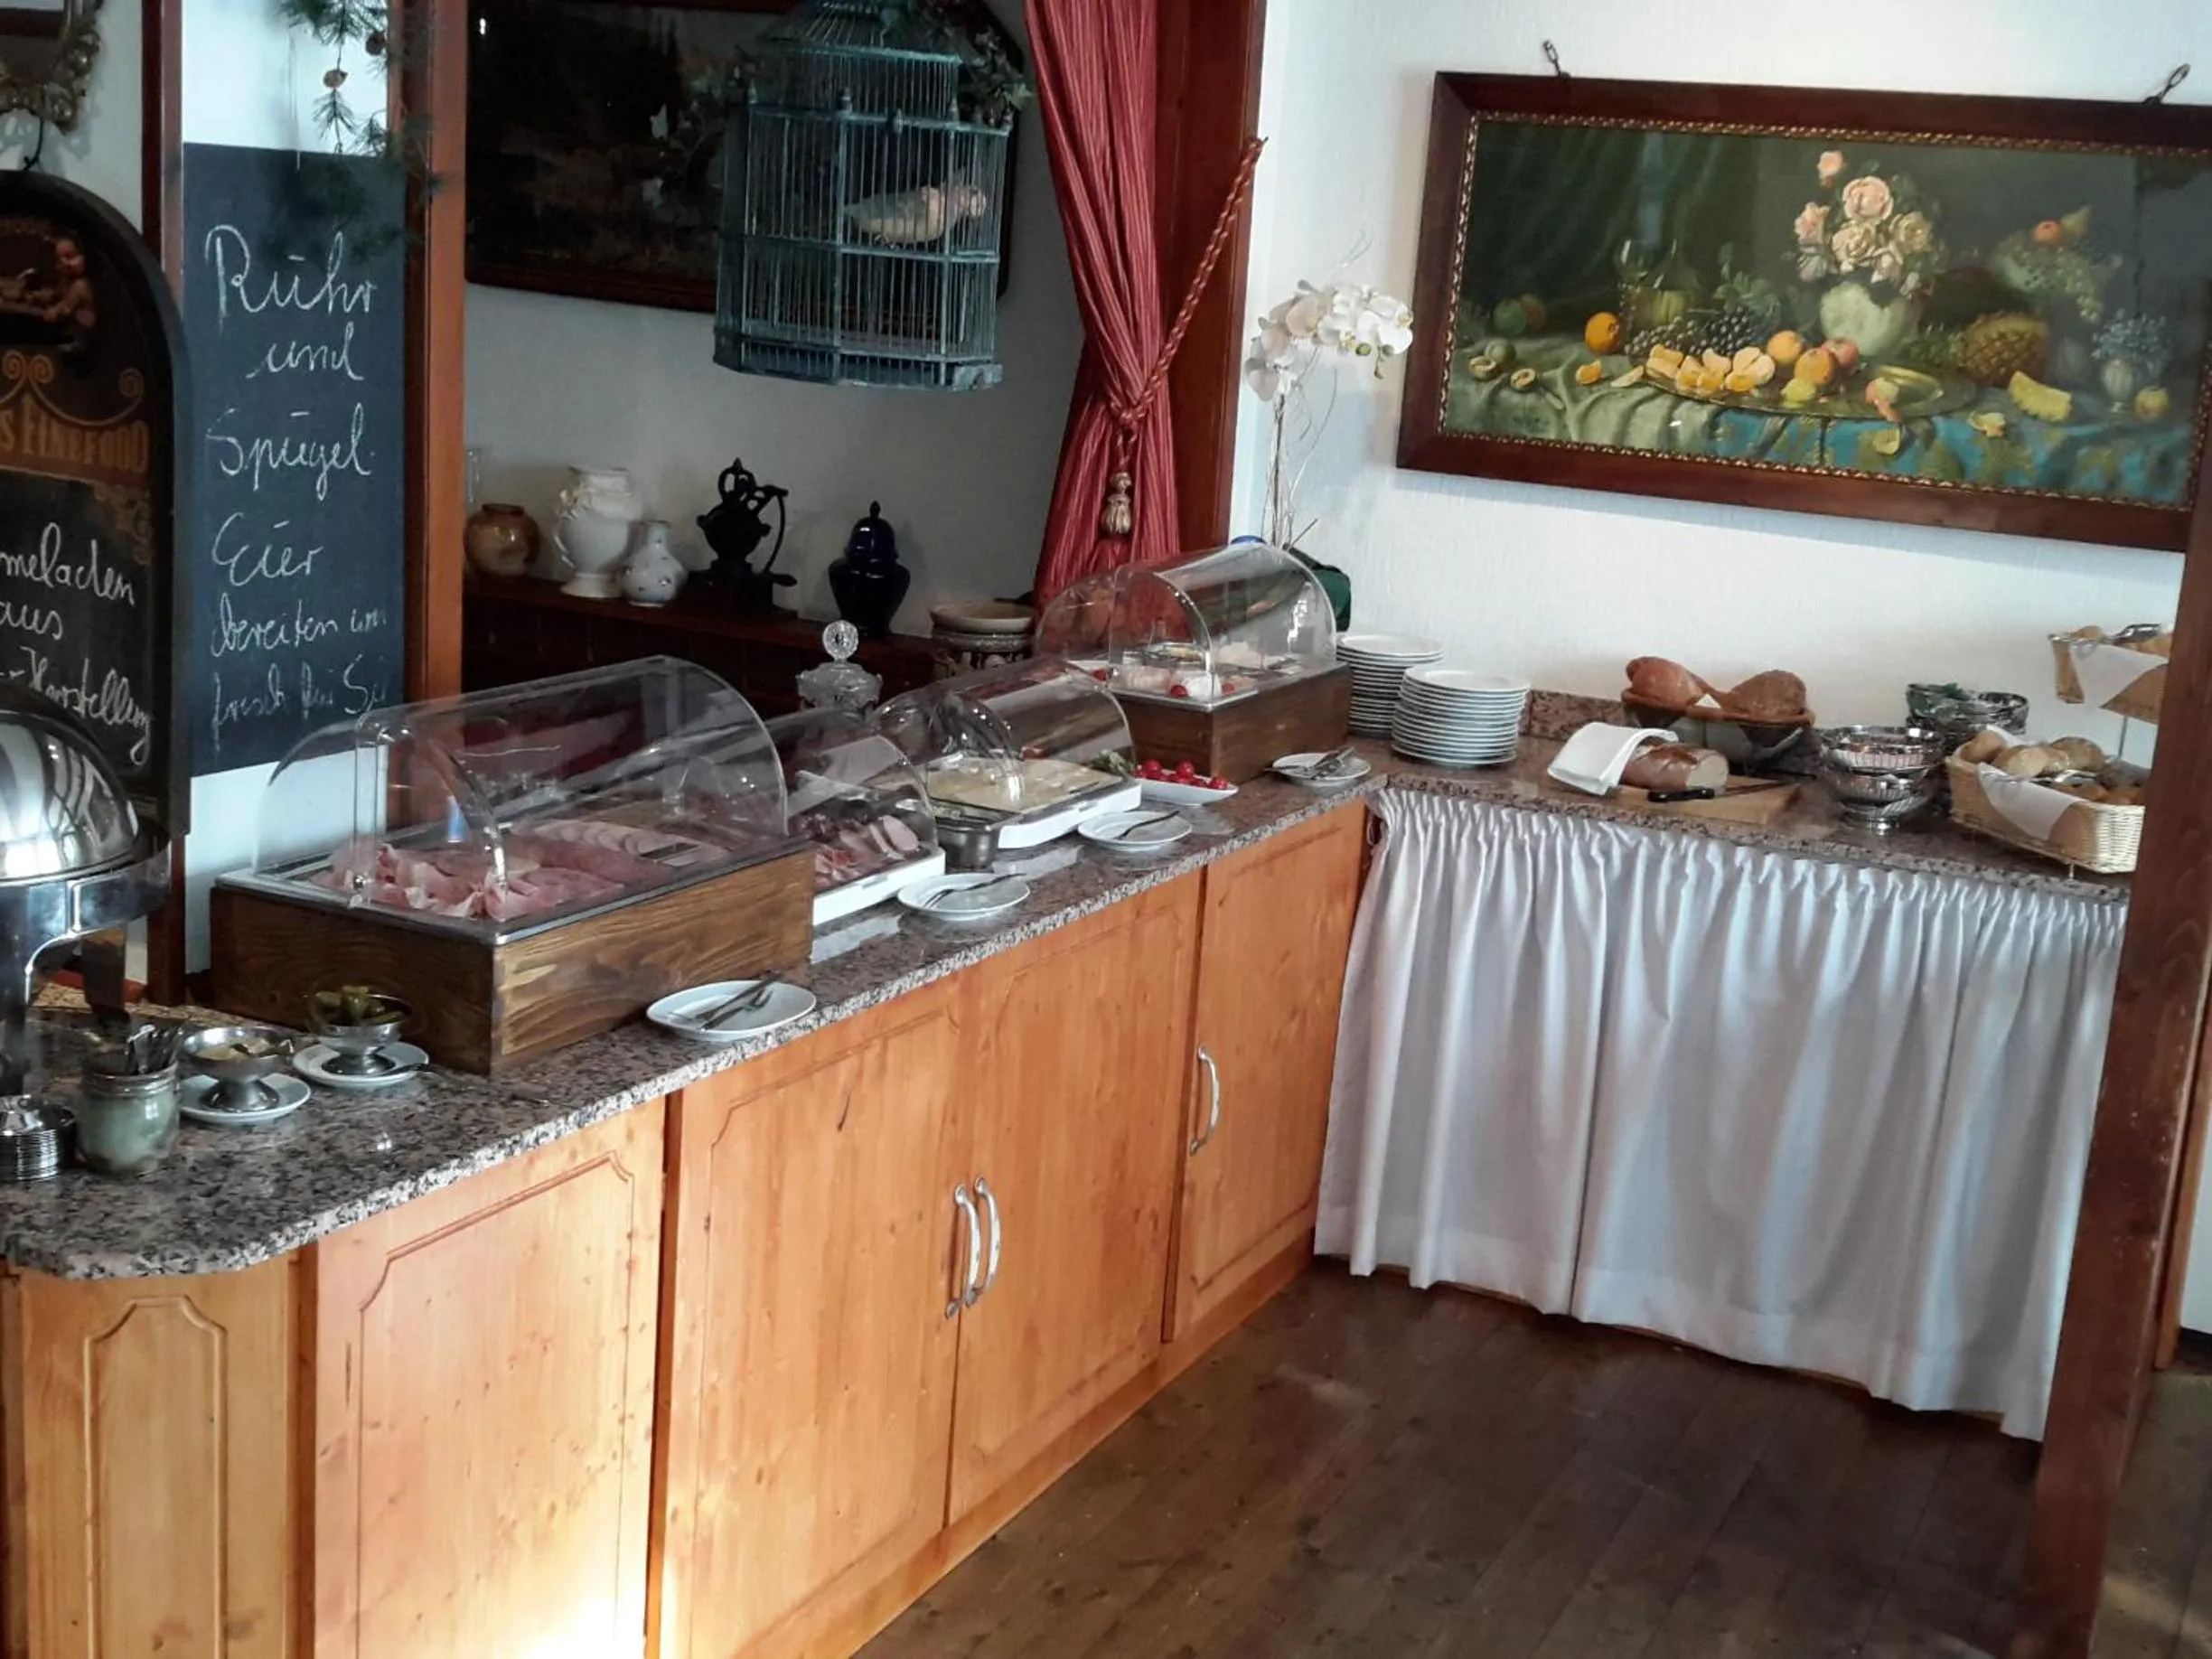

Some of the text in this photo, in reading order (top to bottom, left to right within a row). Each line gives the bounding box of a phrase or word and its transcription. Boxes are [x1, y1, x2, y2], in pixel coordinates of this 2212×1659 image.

[246, 322, 364, 380] und
[212, 512, 324, 586] Eier
[211, 592, 338, 657] bereiten
